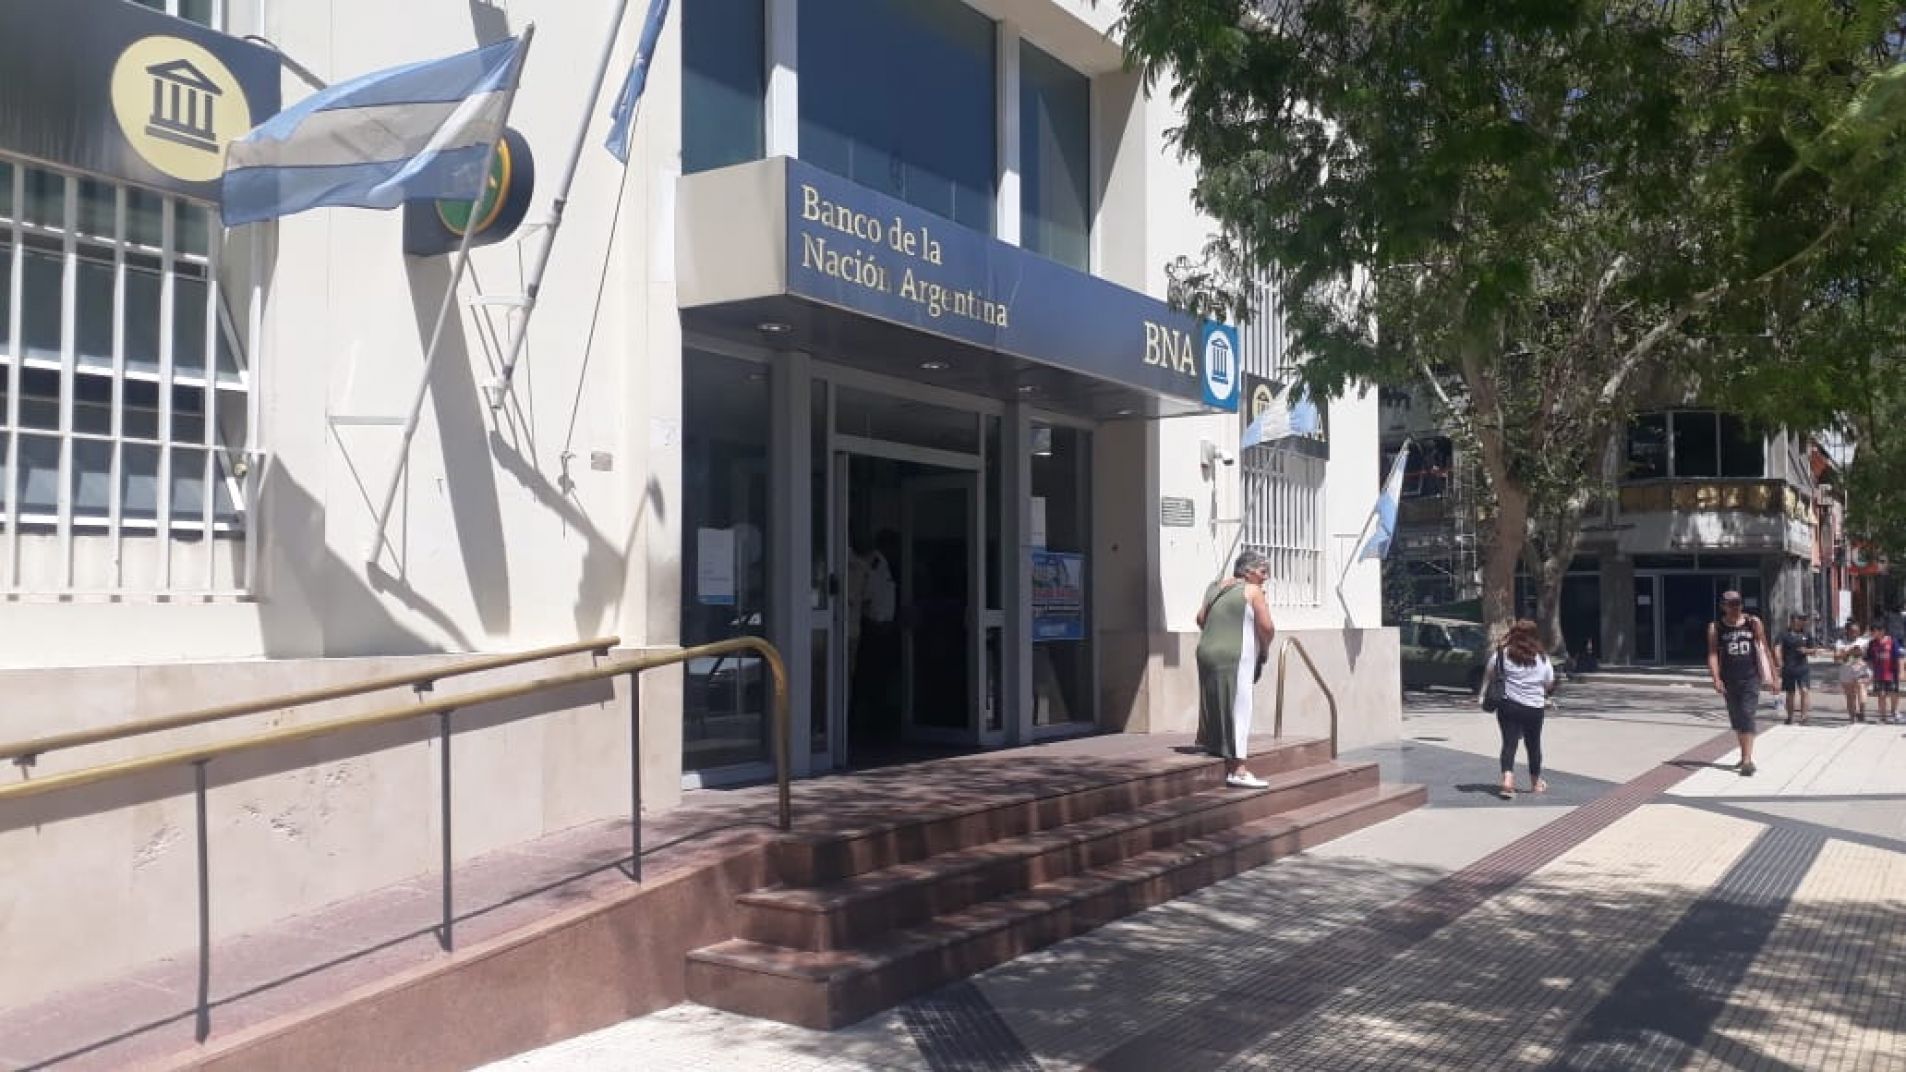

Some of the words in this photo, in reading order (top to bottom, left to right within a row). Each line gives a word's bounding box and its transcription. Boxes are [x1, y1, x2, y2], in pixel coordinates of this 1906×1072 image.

[801, 184, 882, 243] Banco
[889, 216, 916, 256] de
[921, 226, 943, 265] la
[801, 232, 891, 293] Nación
[899, 267, 1009, 328] Argentina
[1143, 320, 1197, 376] BNA
[1728, 641, 1750, 655] 20
